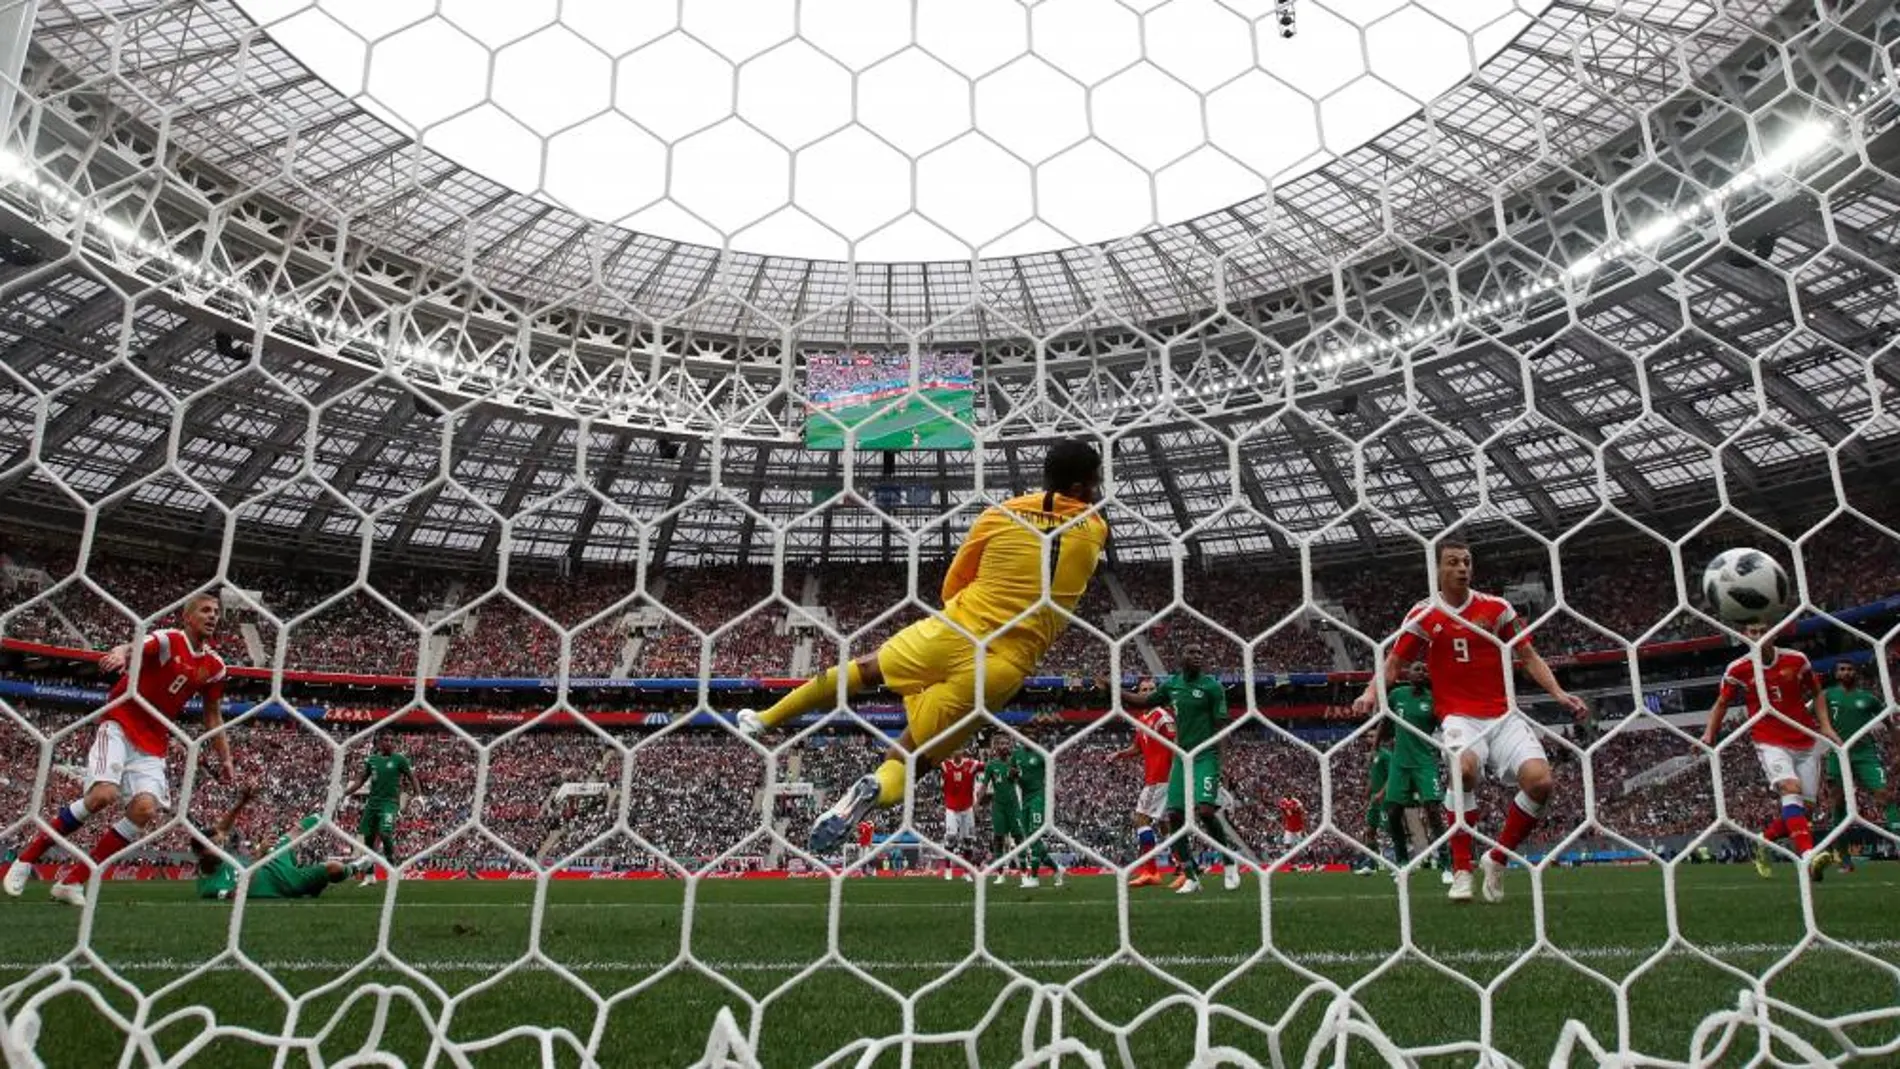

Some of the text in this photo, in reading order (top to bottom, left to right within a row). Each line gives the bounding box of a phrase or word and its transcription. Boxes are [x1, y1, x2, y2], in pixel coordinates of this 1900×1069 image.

[1453, 638, 1470, 662] 9
[168, 674, 188, 695] 8
[1831, 706, 1839, 719] 7
[1203, 776, 1214, 791] 5
[1032, 812, 1043, 824] 13
